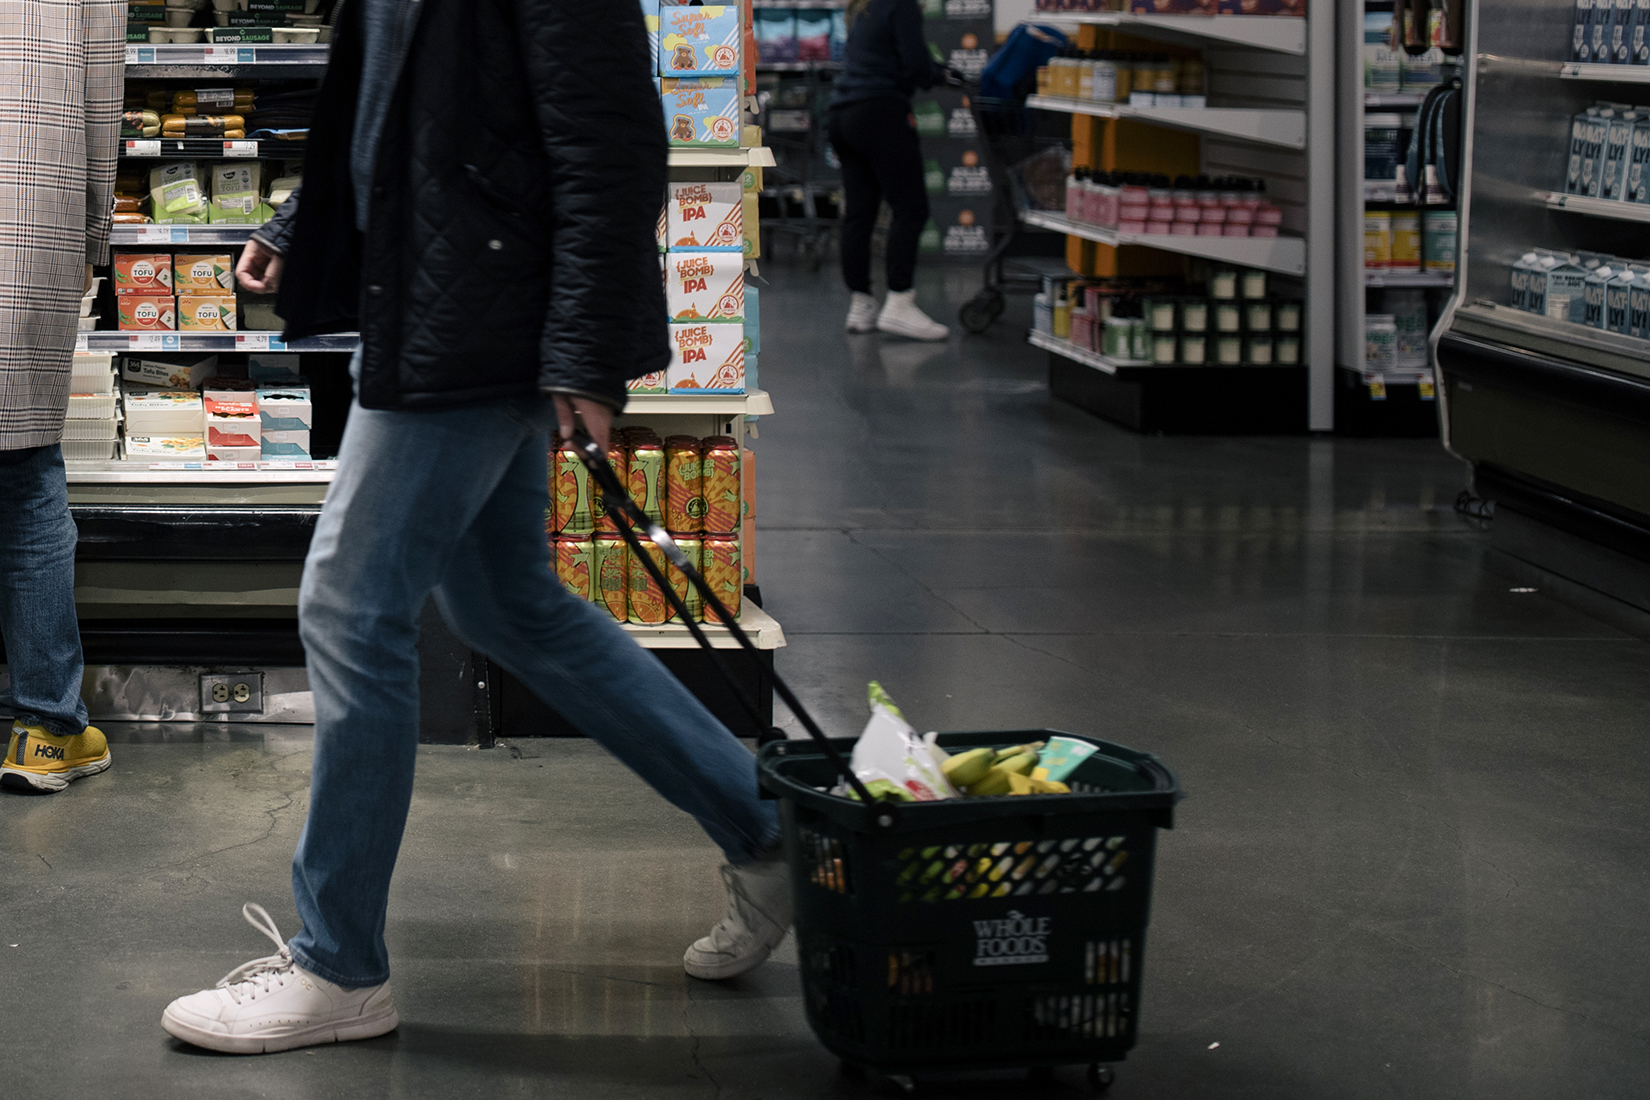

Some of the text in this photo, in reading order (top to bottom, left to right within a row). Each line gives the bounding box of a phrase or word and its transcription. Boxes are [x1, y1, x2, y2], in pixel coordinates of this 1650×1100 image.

[671, 11, 712, 25] Super
[676, 22, 706, 38] Soft
[683, 206, 706, 222] IPA
[134, 269, 154, 277] TOFU
[684, 278, 707, 294] IPA
[683, 348, 707, 364] IPA
[35, 744, 65, 761] HOKA
[973, 917, 1051, 938] WHOLE
[976, 937, 1048, 957] FOODS
